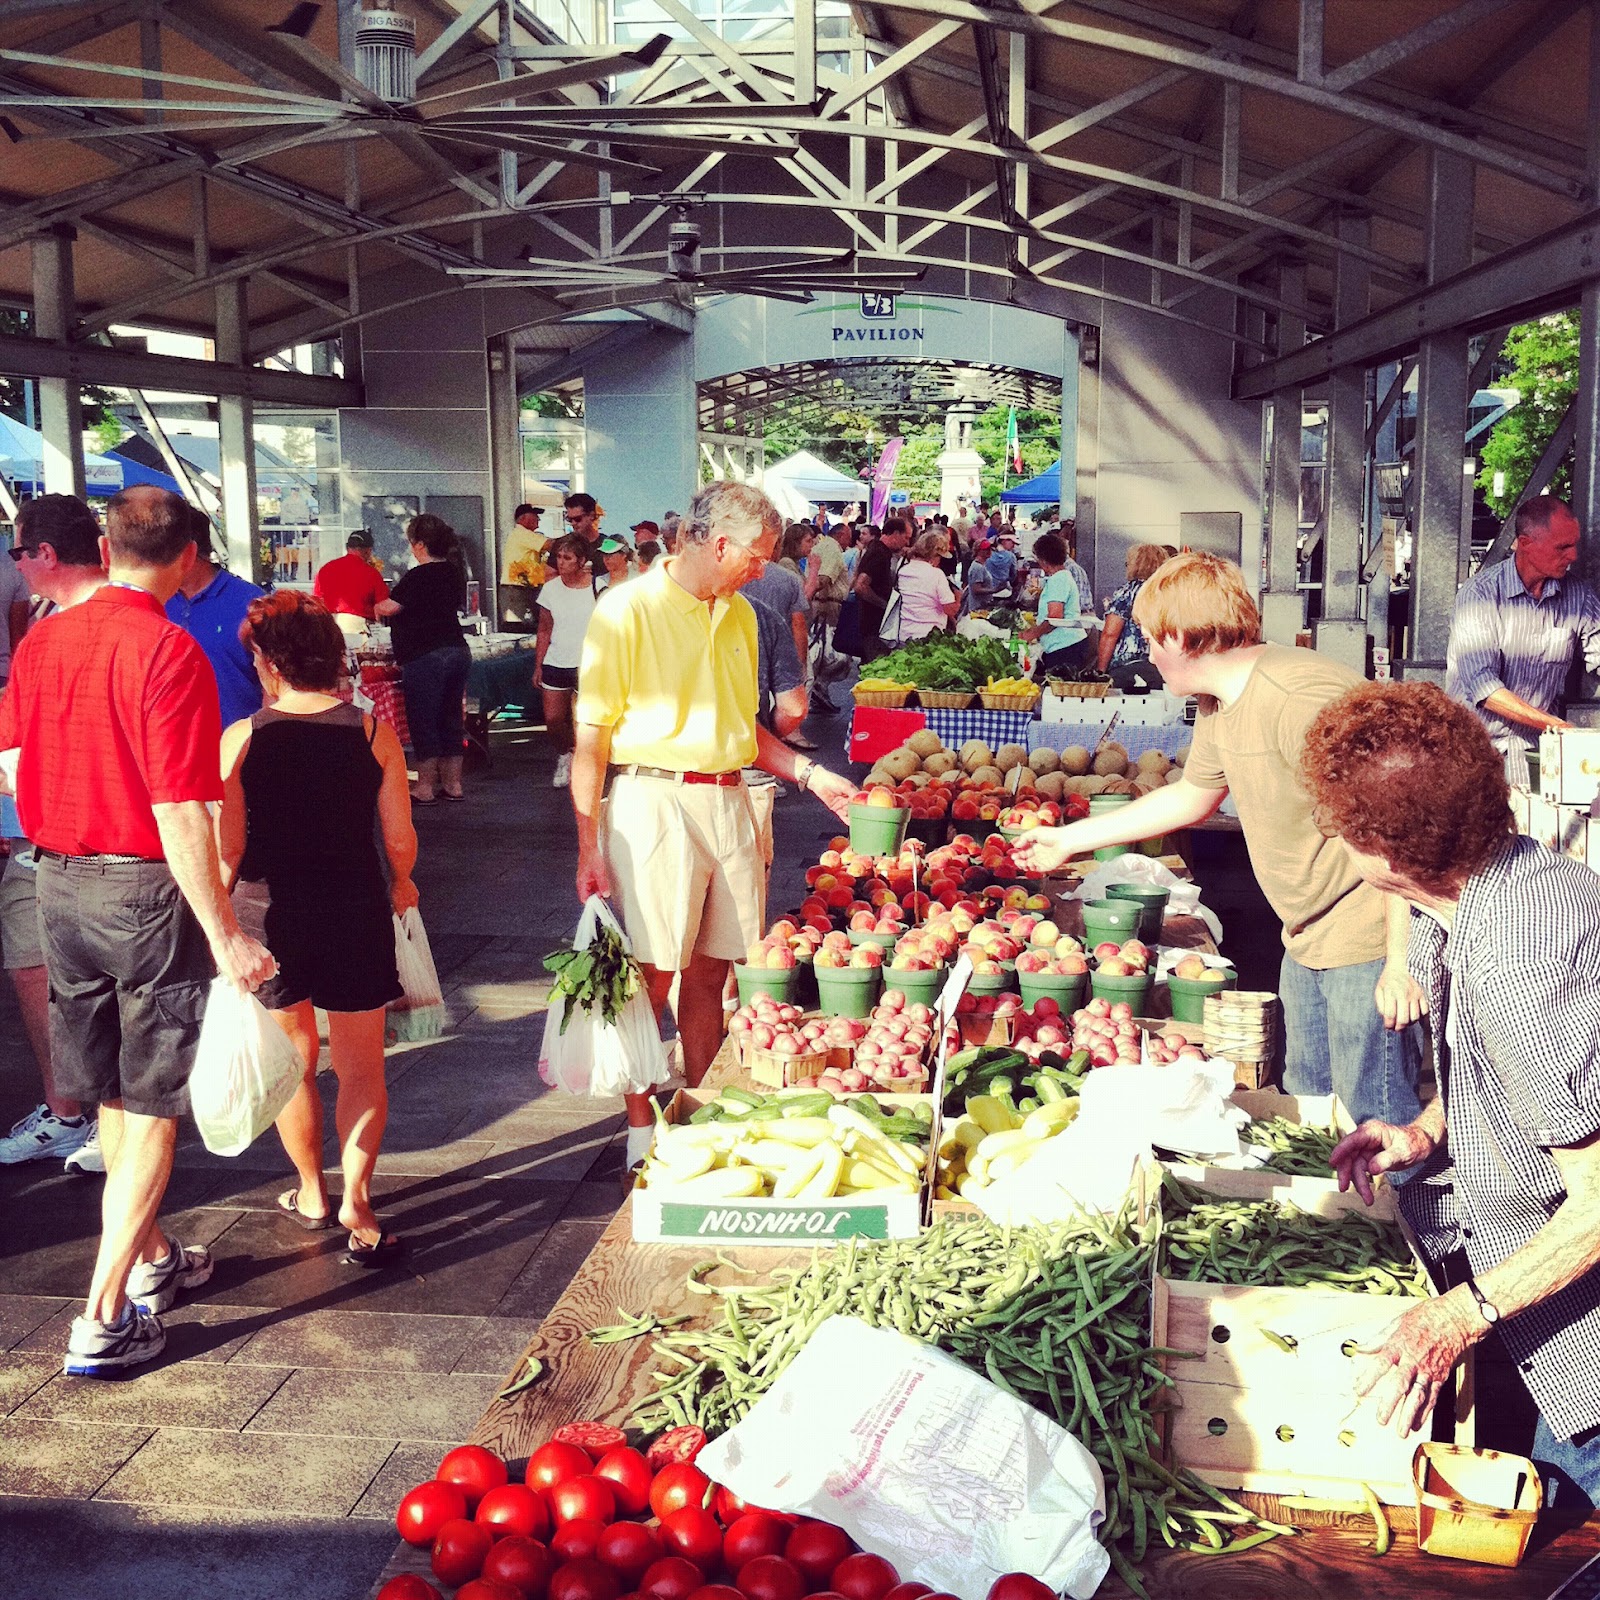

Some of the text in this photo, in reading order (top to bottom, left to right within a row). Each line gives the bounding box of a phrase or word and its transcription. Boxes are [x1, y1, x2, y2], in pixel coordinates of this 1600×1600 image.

[367, 17, 384, 26] BIG
[386, 17, 404, 28] ASS
[831, 327, 925, 341] PAVILION
[698, 1209, 851, 1234] JOHNSON
[943, 1211, 986, 1223] OES
[904, 1372, 925, 1396] Please
[889, 1396, 908, 1418] return
[884, 1418, 896, 1428] to
